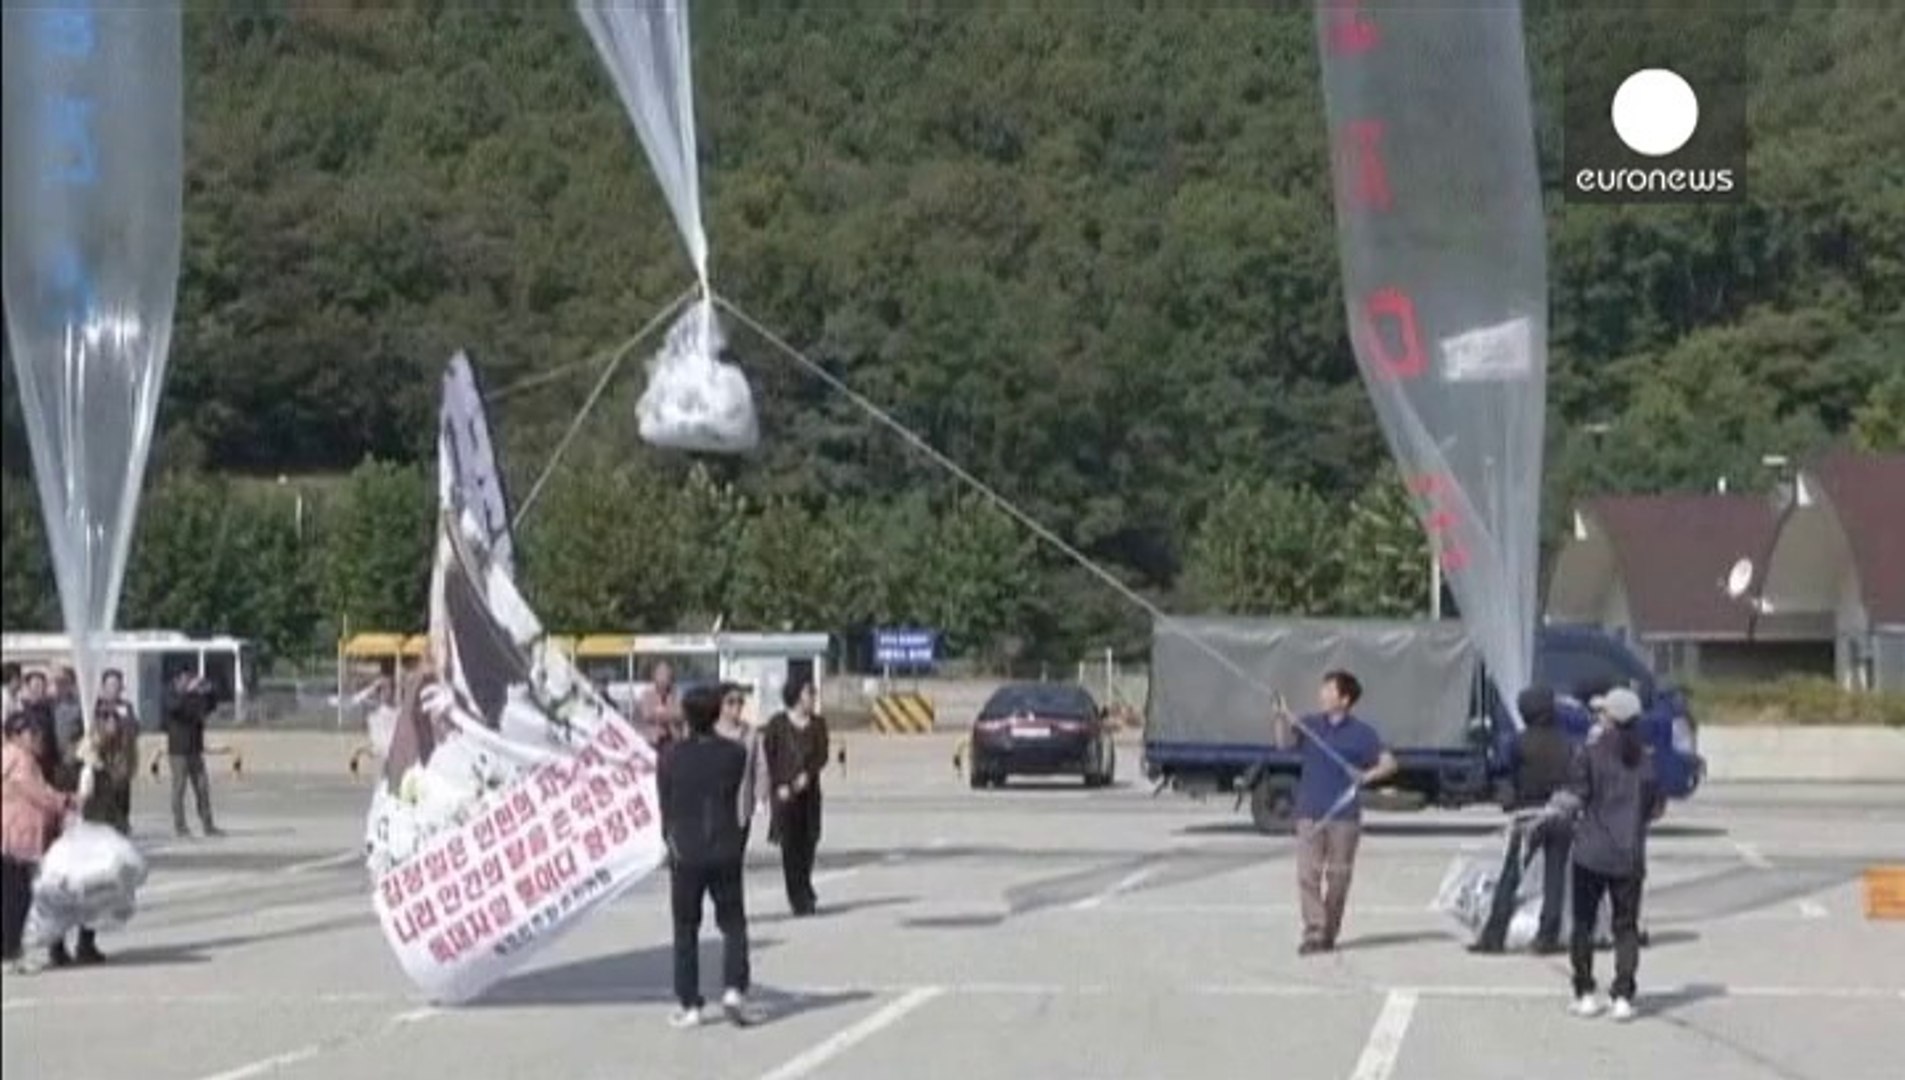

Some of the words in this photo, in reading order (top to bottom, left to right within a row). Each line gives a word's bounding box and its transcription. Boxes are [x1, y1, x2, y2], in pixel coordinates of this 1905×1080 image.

[381, 836, 468, 909] 김정일은
[473, 786, 536, 851] 인민의
[437, 853, 504, 915] 인간의
